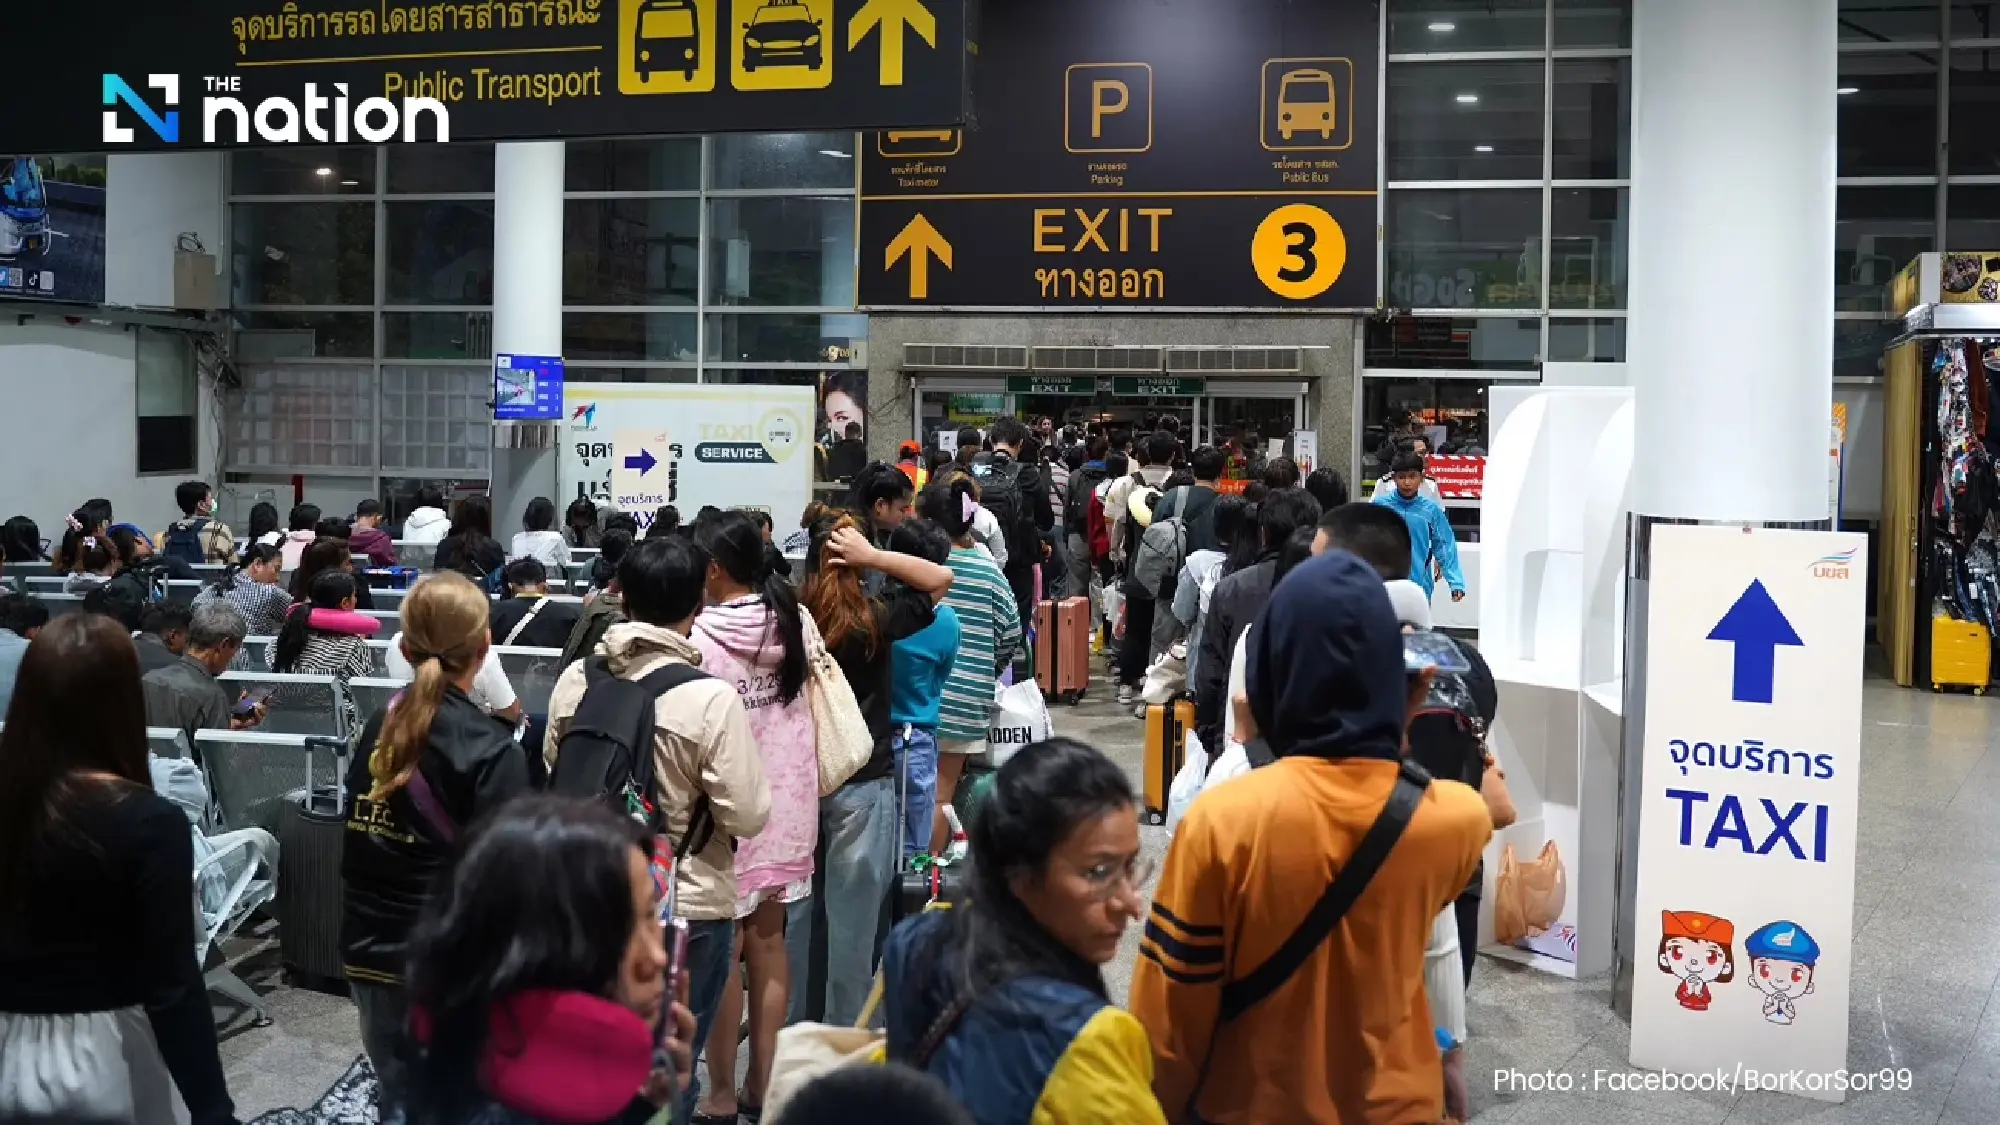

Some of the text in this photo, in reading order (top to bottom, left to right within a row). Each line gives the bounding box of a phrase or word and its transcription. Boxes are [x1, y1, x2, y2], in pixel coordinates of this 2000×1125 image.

[385, 66, 602, 106] Public Transport
[1091, 174, 1123, 187] Parking
[1282, 171, 1329, 182] Public Bus
[1033, 208, 1173, 252] EXIT
[1277, 221, 1318, 283] 3
[1034, 268, 1165, 298] ทางออก
[1031, 385, 1072, 393] EXIT
[1138, 386, 1179, 395] EXIT
[702, 447, 763, 459] SERVICE
[1668, 739, 1835, 780] จุดบริการ
[1665, 787, 1829, 863] TAXI
